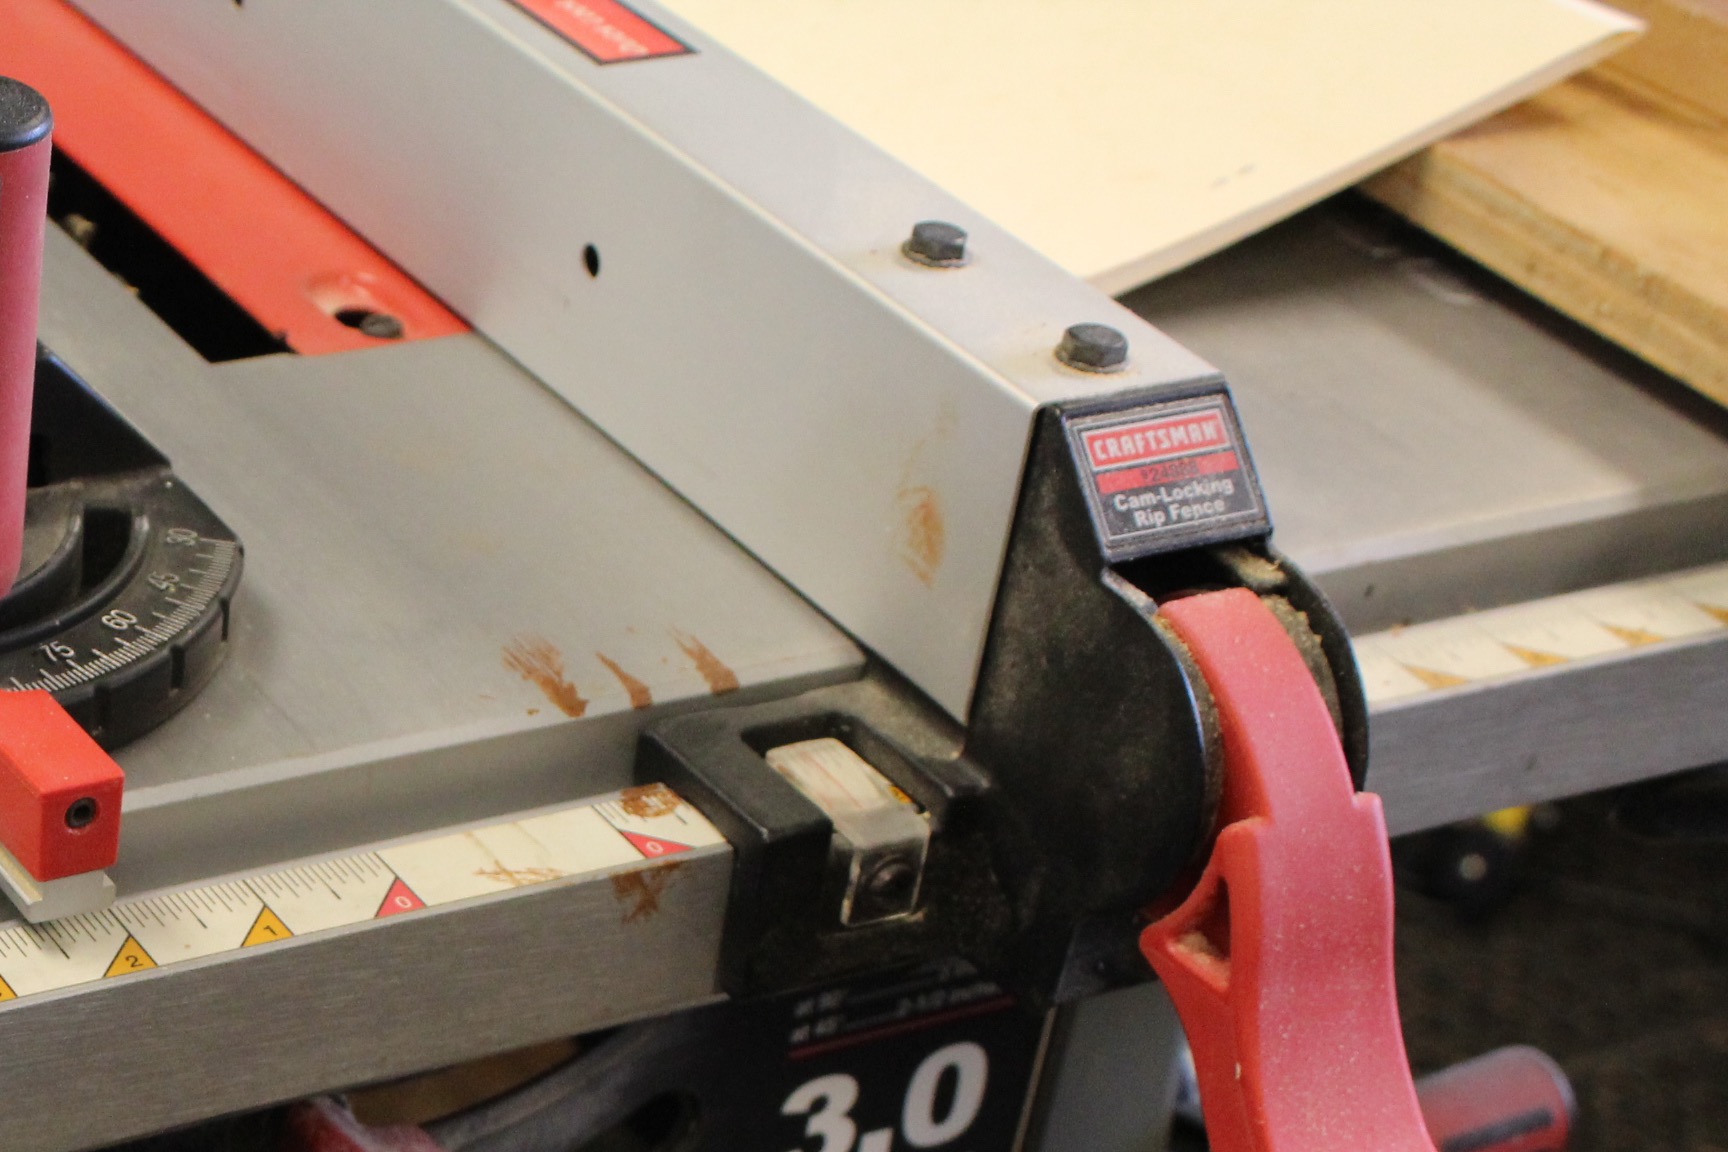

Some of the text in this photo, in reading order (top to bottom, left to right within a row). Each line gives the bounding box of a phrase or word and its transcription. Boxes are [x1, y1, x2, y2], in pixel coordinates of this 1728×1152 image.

[1092, 421, 1218, 460] CRAFTSMAN
[1113, 477, 1235, 512] Cam-Locking
[1134, 499, 1225, 528] Rip Fence
[102, 609, 138, 631] 60
[40, 641, 75, 663] 75
[645, 841, 663, 854] 0
[395, 896, 412, 909] 0
[262, 923, 278, 937] 1
[124, 954, 144, 969] 2
